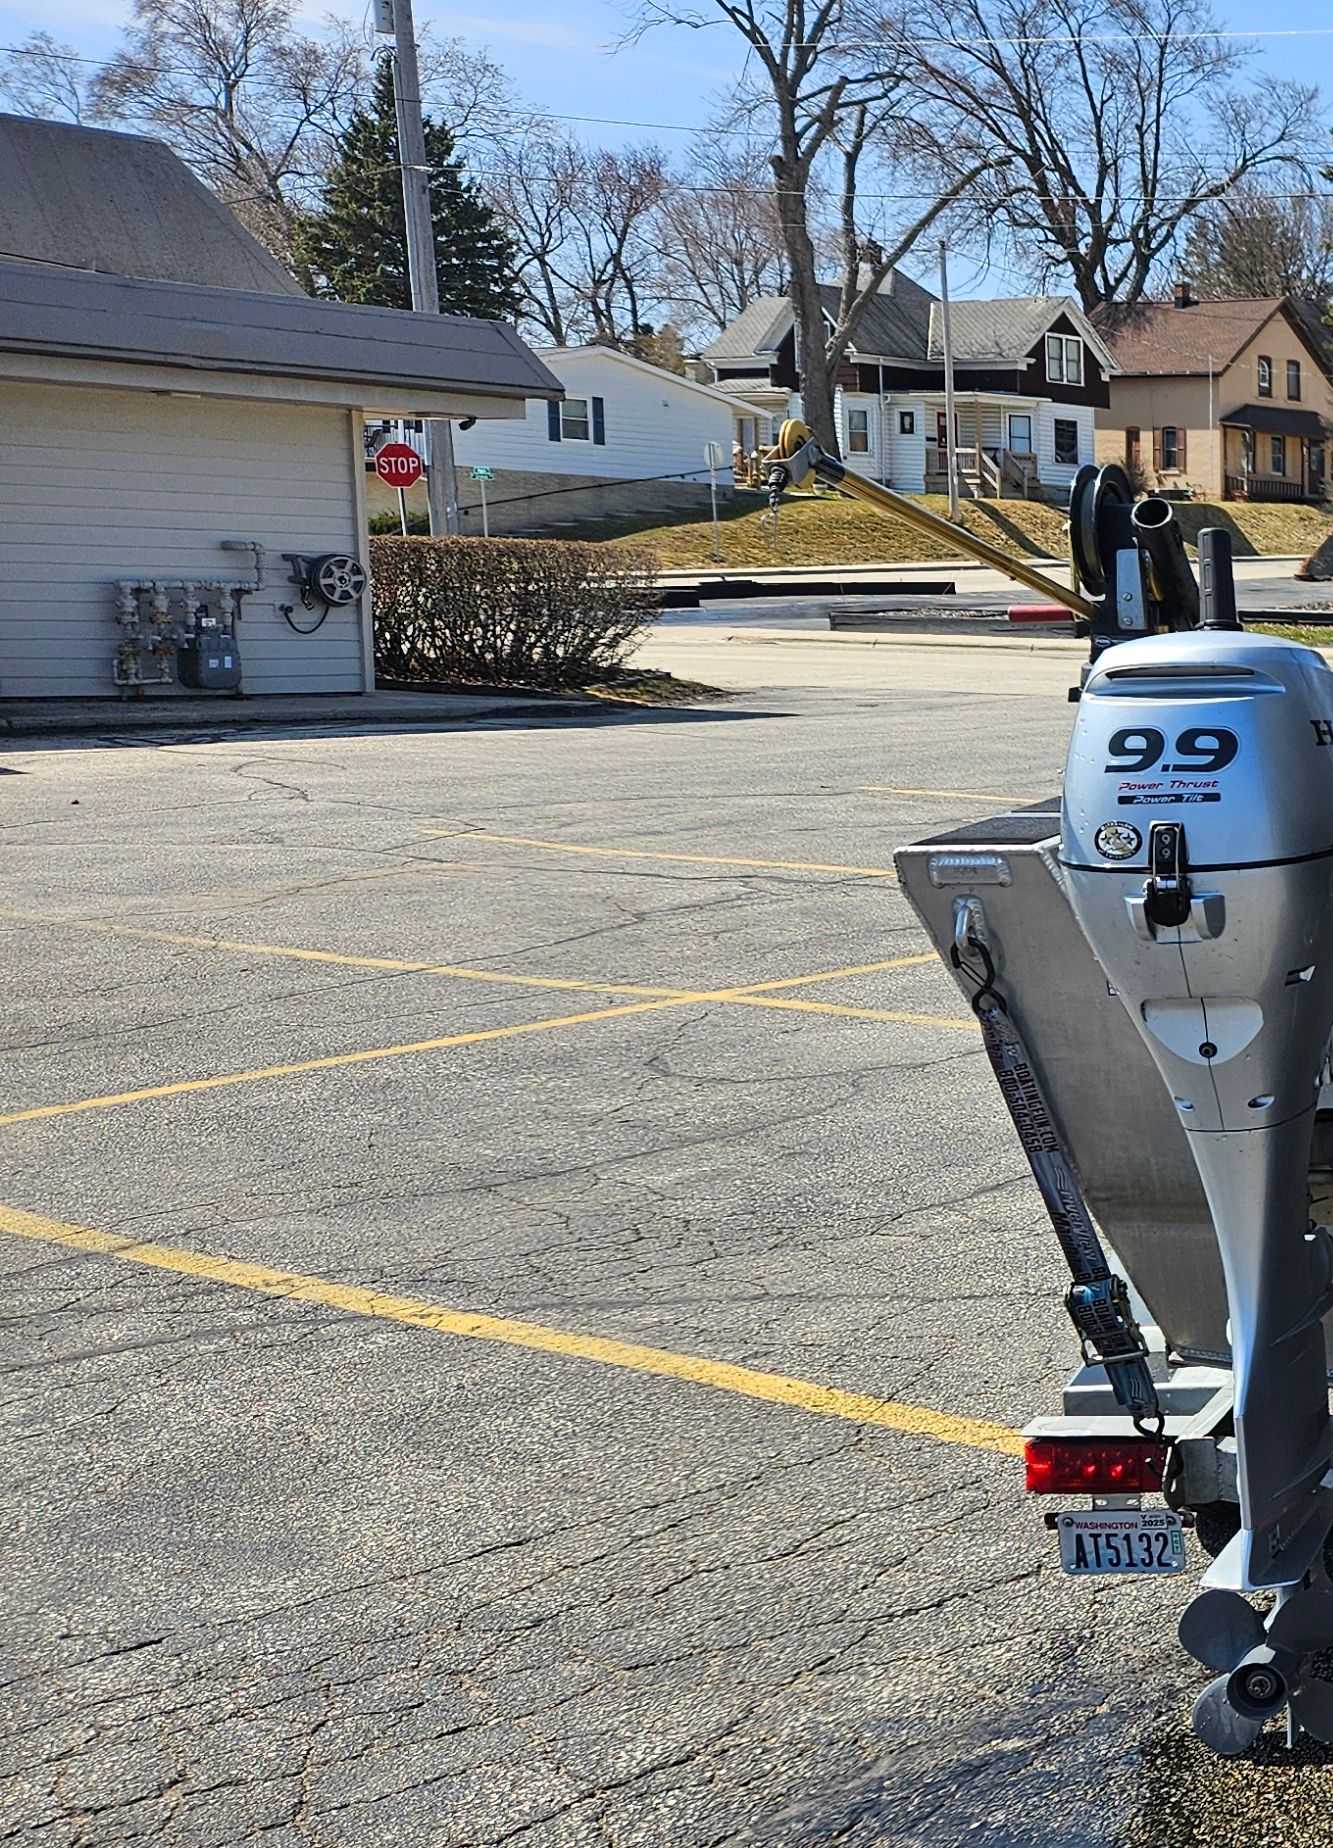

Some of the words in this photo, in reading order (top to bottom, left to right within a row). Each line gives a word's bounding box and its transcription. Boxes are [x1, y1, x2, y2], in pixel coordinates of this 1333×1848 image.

[380, 457, 419, 474] STOP
[1104, 727, 1239, 773] 9.9
[1119, 782, 1163, 791] Power
[1170, 780, 1219, 788] Thrust
[1133, 795, 1176, 804] Power
[1182, 793, 1204, 802] Tilt
[1014, 1062, 1060, 1153] BOATINGFUN.COM
[1074, 1521, 1138, 1530] WASHINGTON
[1075, 1532, 1172, 1569] AT5132
